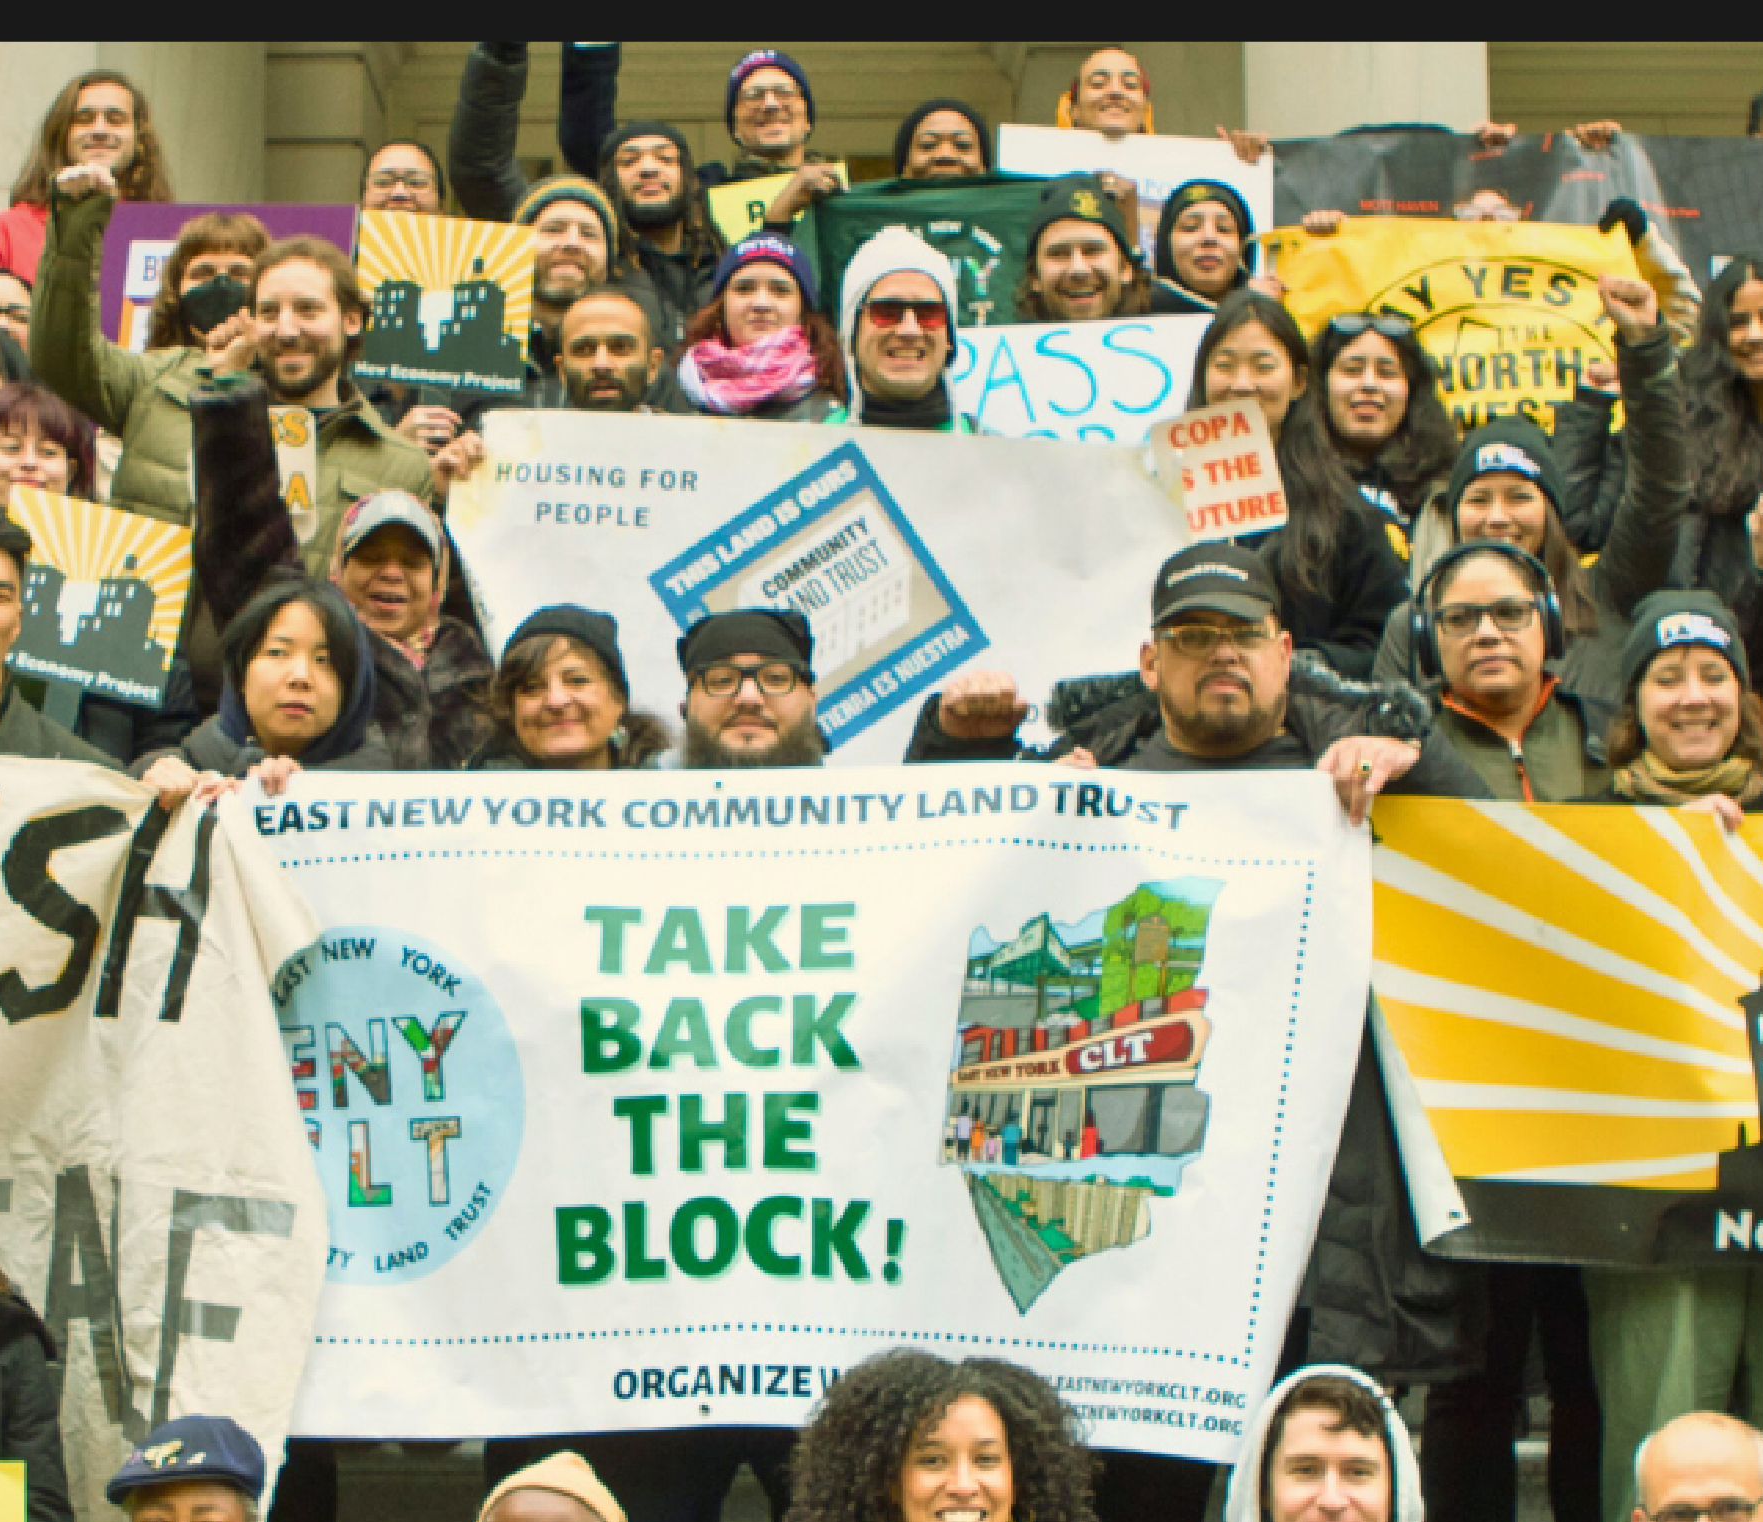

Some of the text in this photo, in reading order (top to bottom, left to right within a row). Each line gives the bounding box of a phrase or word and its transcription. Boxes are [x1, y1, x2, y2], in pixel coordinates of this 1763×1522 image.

[1169, 412, 1251, 448] COPA
[495, 462, 698, 491] HOUSING FOR
[1202, 452, 1262, 484] THE
[536, 502, 650, 528] PEOPLE
[716, 514, 779, 564] LAND
[797, 459, 860, 511] OURS
[1187, 491, 1285, 531] UTURE
[762, 516, 870, 600] COMMUNITY
[830, 539, 890, 596] TRUST
[255, 781, 1190, 836] EAST NEW YORK COMMUNITY LAND TRUST
[321, 937, 376, 963] NEW
[400, 945, 462, 997] YORK
[583, 901, 859, 976] TAKE
[579, 993, 862, 1076] BACK
[1079, 1030, 1154, 1074] CLT
[612, 1090, 821, 1176] THE
[373, 1241, 429, 1274] LAND
[442, 1181, 492, 1240] TRUST
[554, 1194, 909, 1288] BLOCK!
[613, 1364, 809, 1402] ORGANIZE
